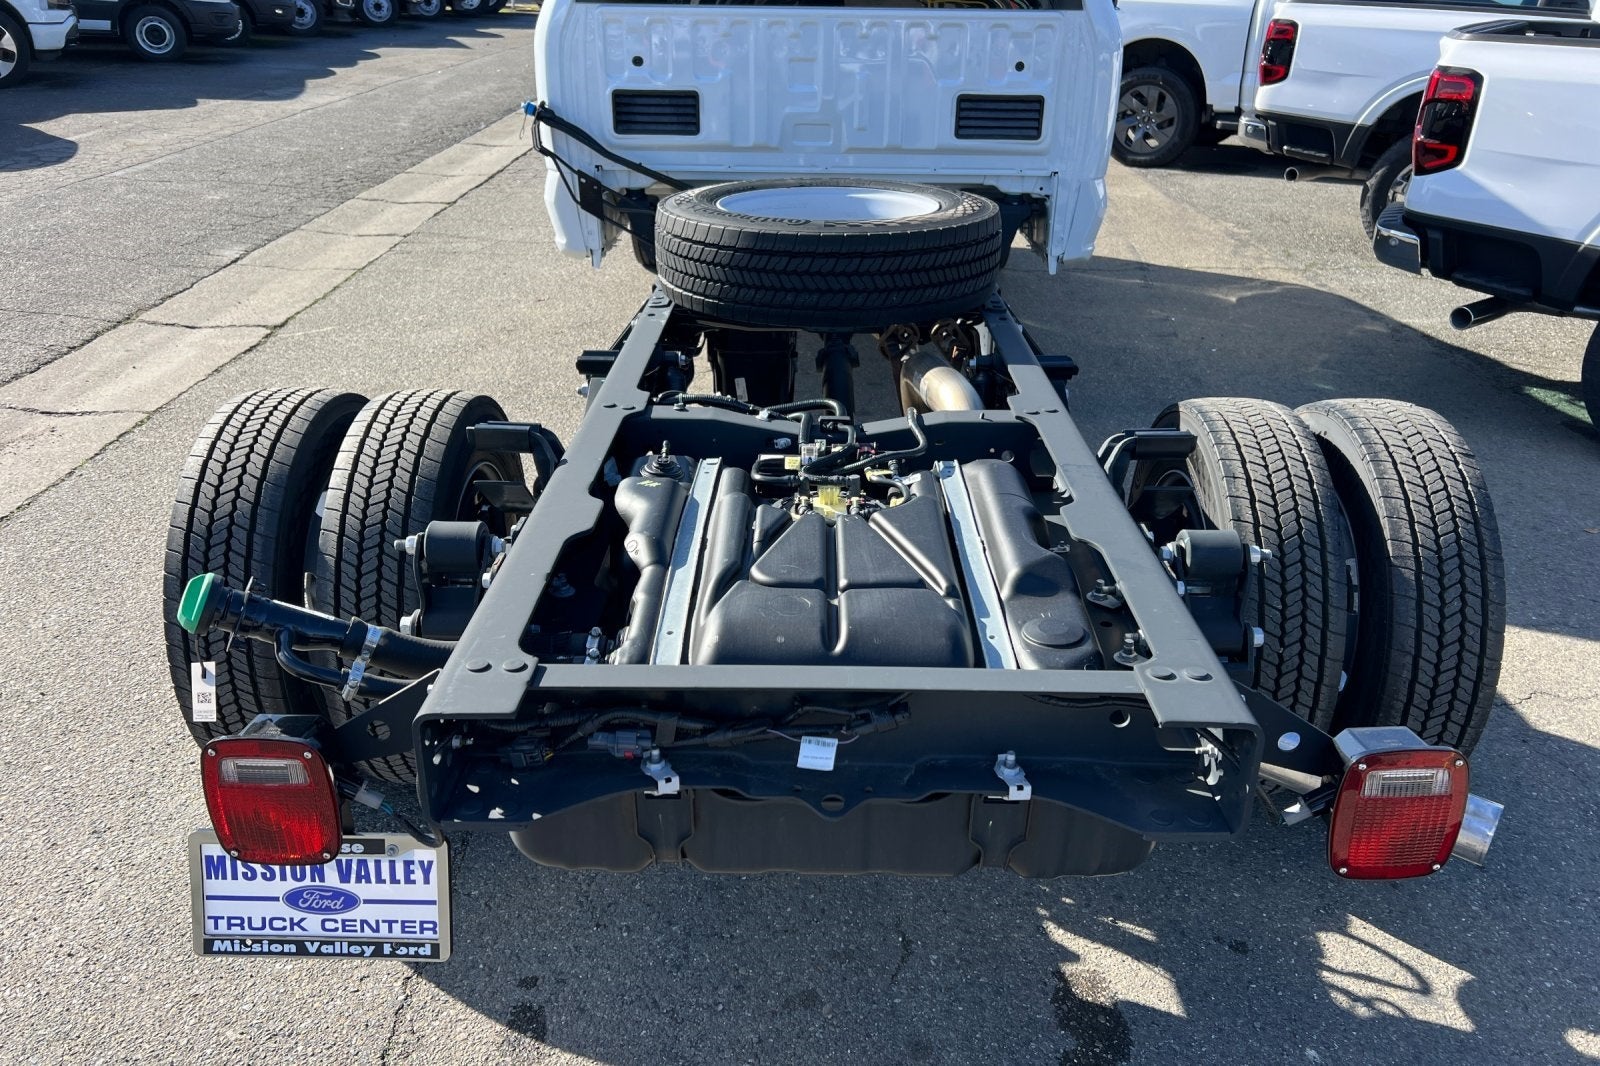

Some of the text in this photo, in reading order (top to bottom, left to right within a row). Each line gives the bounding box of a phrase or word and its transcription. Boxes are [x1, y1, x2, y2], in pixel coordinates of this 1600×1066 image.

[205, 855, 434, 885] MISSION VALLEY
[299, 890, 344, 910] Ford
[207, 916, 438, 935] TRUCK CENTER
[304, 941, 375, 957] Valley
[383, 943, 431, 956] Ford
